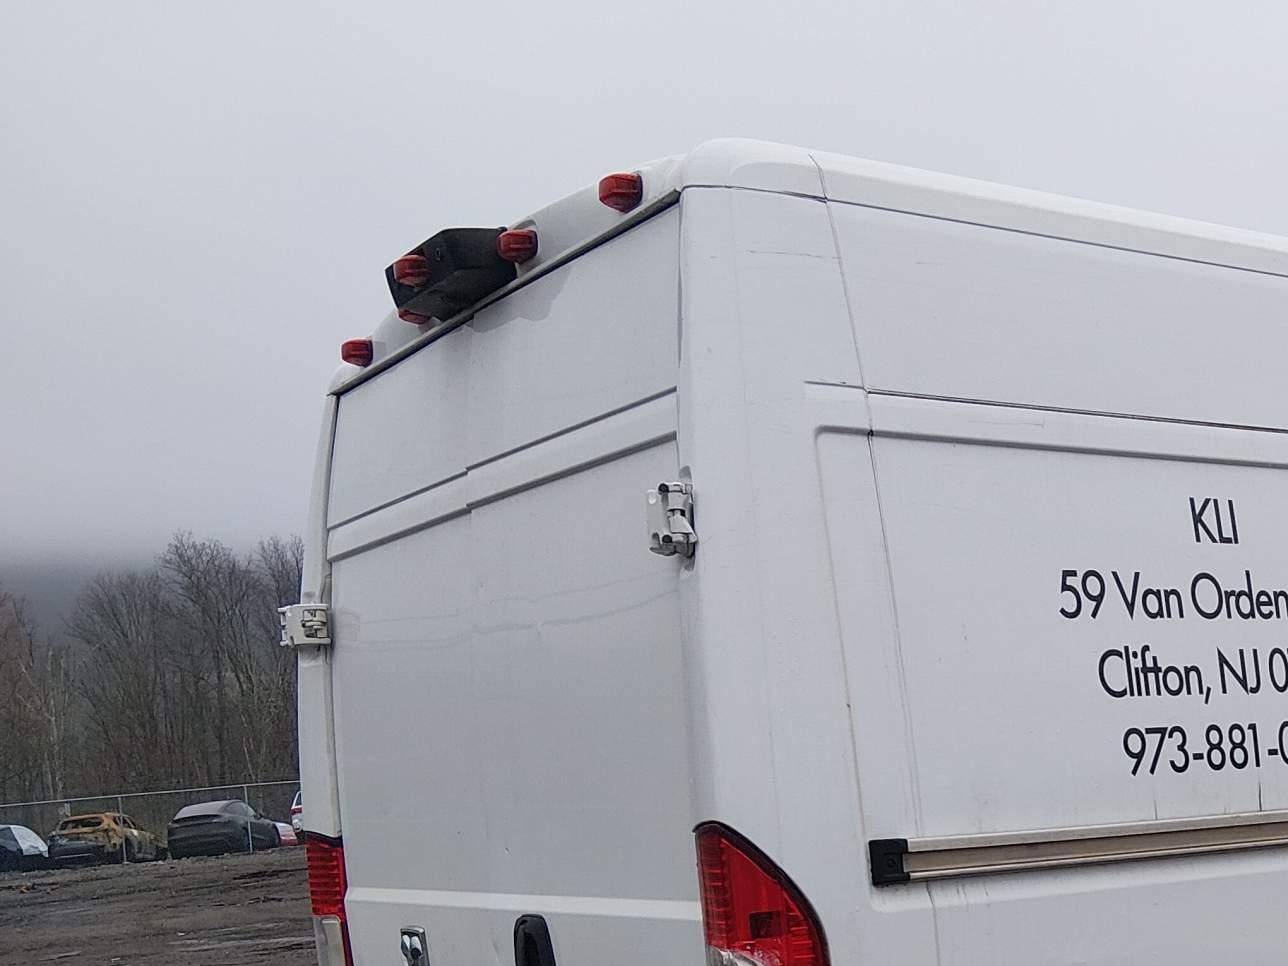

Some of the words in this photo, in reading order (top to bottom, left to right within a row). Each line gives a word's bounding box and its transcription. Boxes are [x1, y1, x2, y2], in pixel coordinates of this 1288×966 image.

[1188, 496, 1239, 545] KLI
[1059, 569, 1106, 620] 59
[1111, 570, 1185, 620] Van
[1098, 644, 1212, 705] Clifton,
[1216, 647, 1262, 696] NJ
